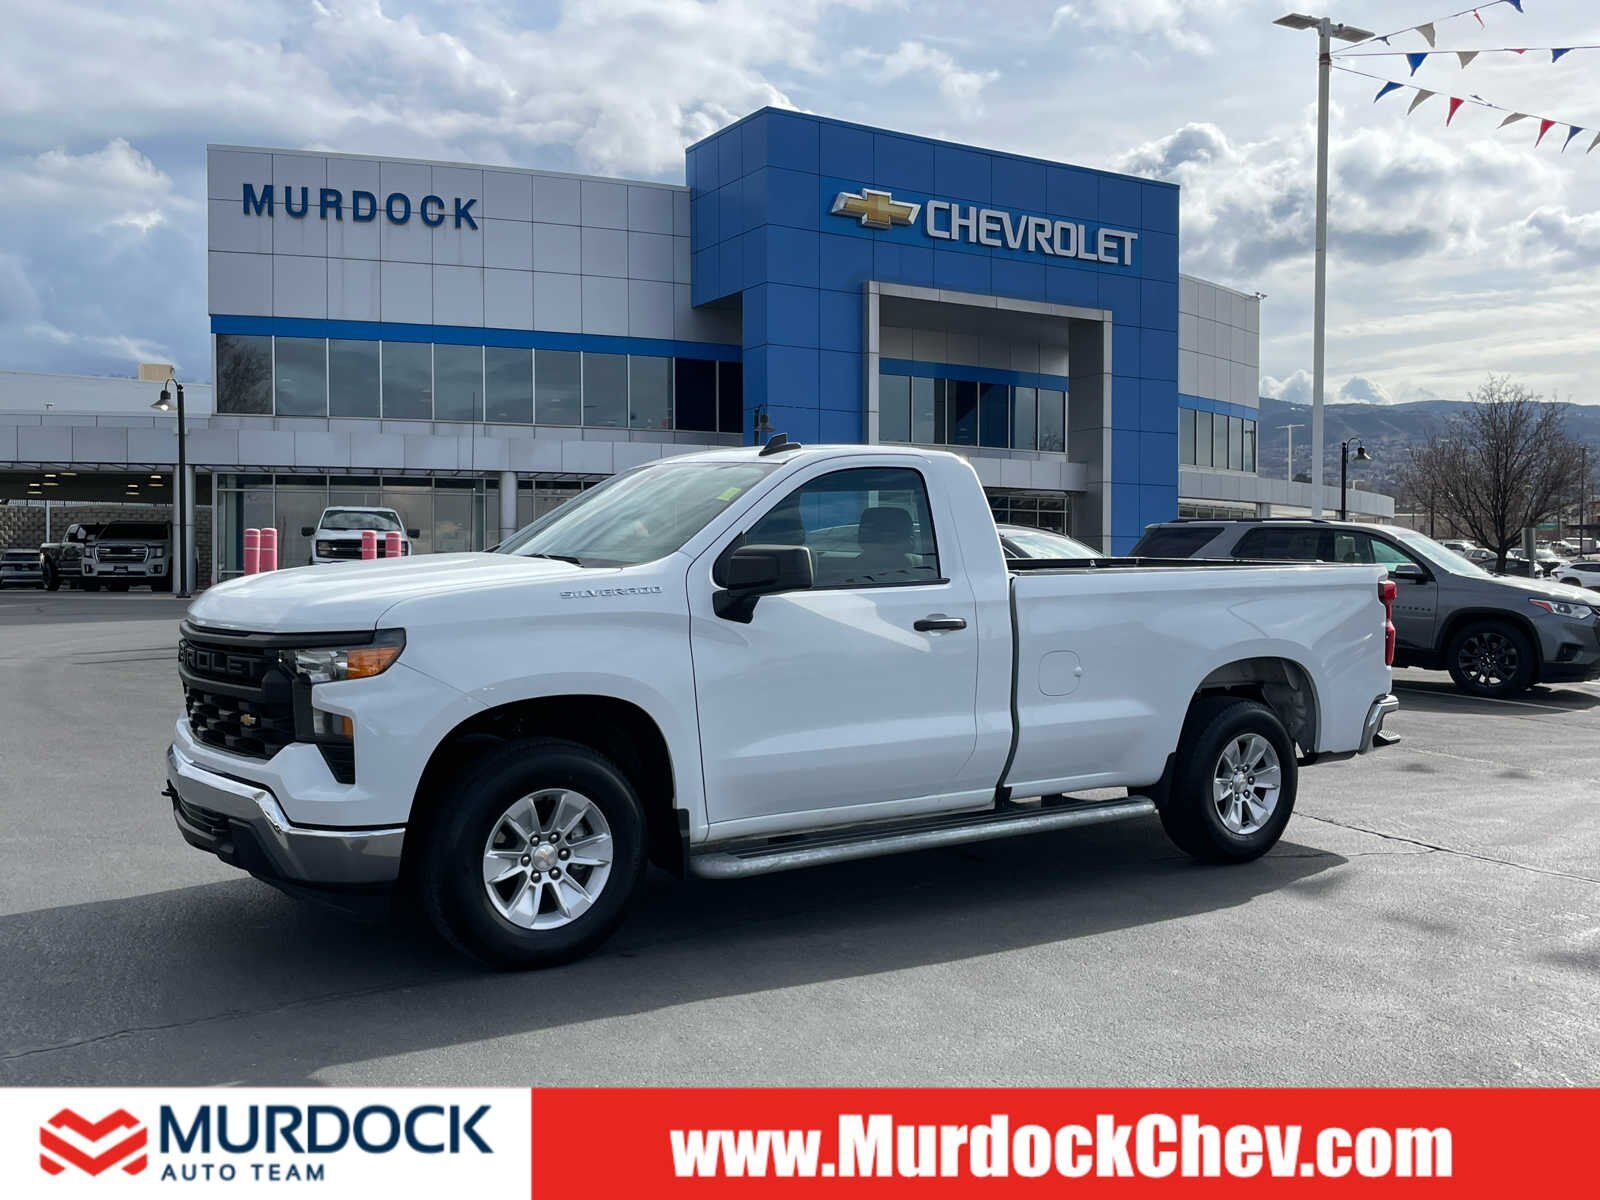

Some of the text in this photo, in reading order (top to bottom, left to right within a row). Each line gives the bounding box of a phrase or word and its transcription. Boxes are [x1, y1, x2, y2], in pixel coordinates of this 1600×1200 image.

[243, 183, 478, 230] MURDOCK
[926, 199, 1138, 266] CHEVROLET
[560, 586, 663, 600] SILVERADO
